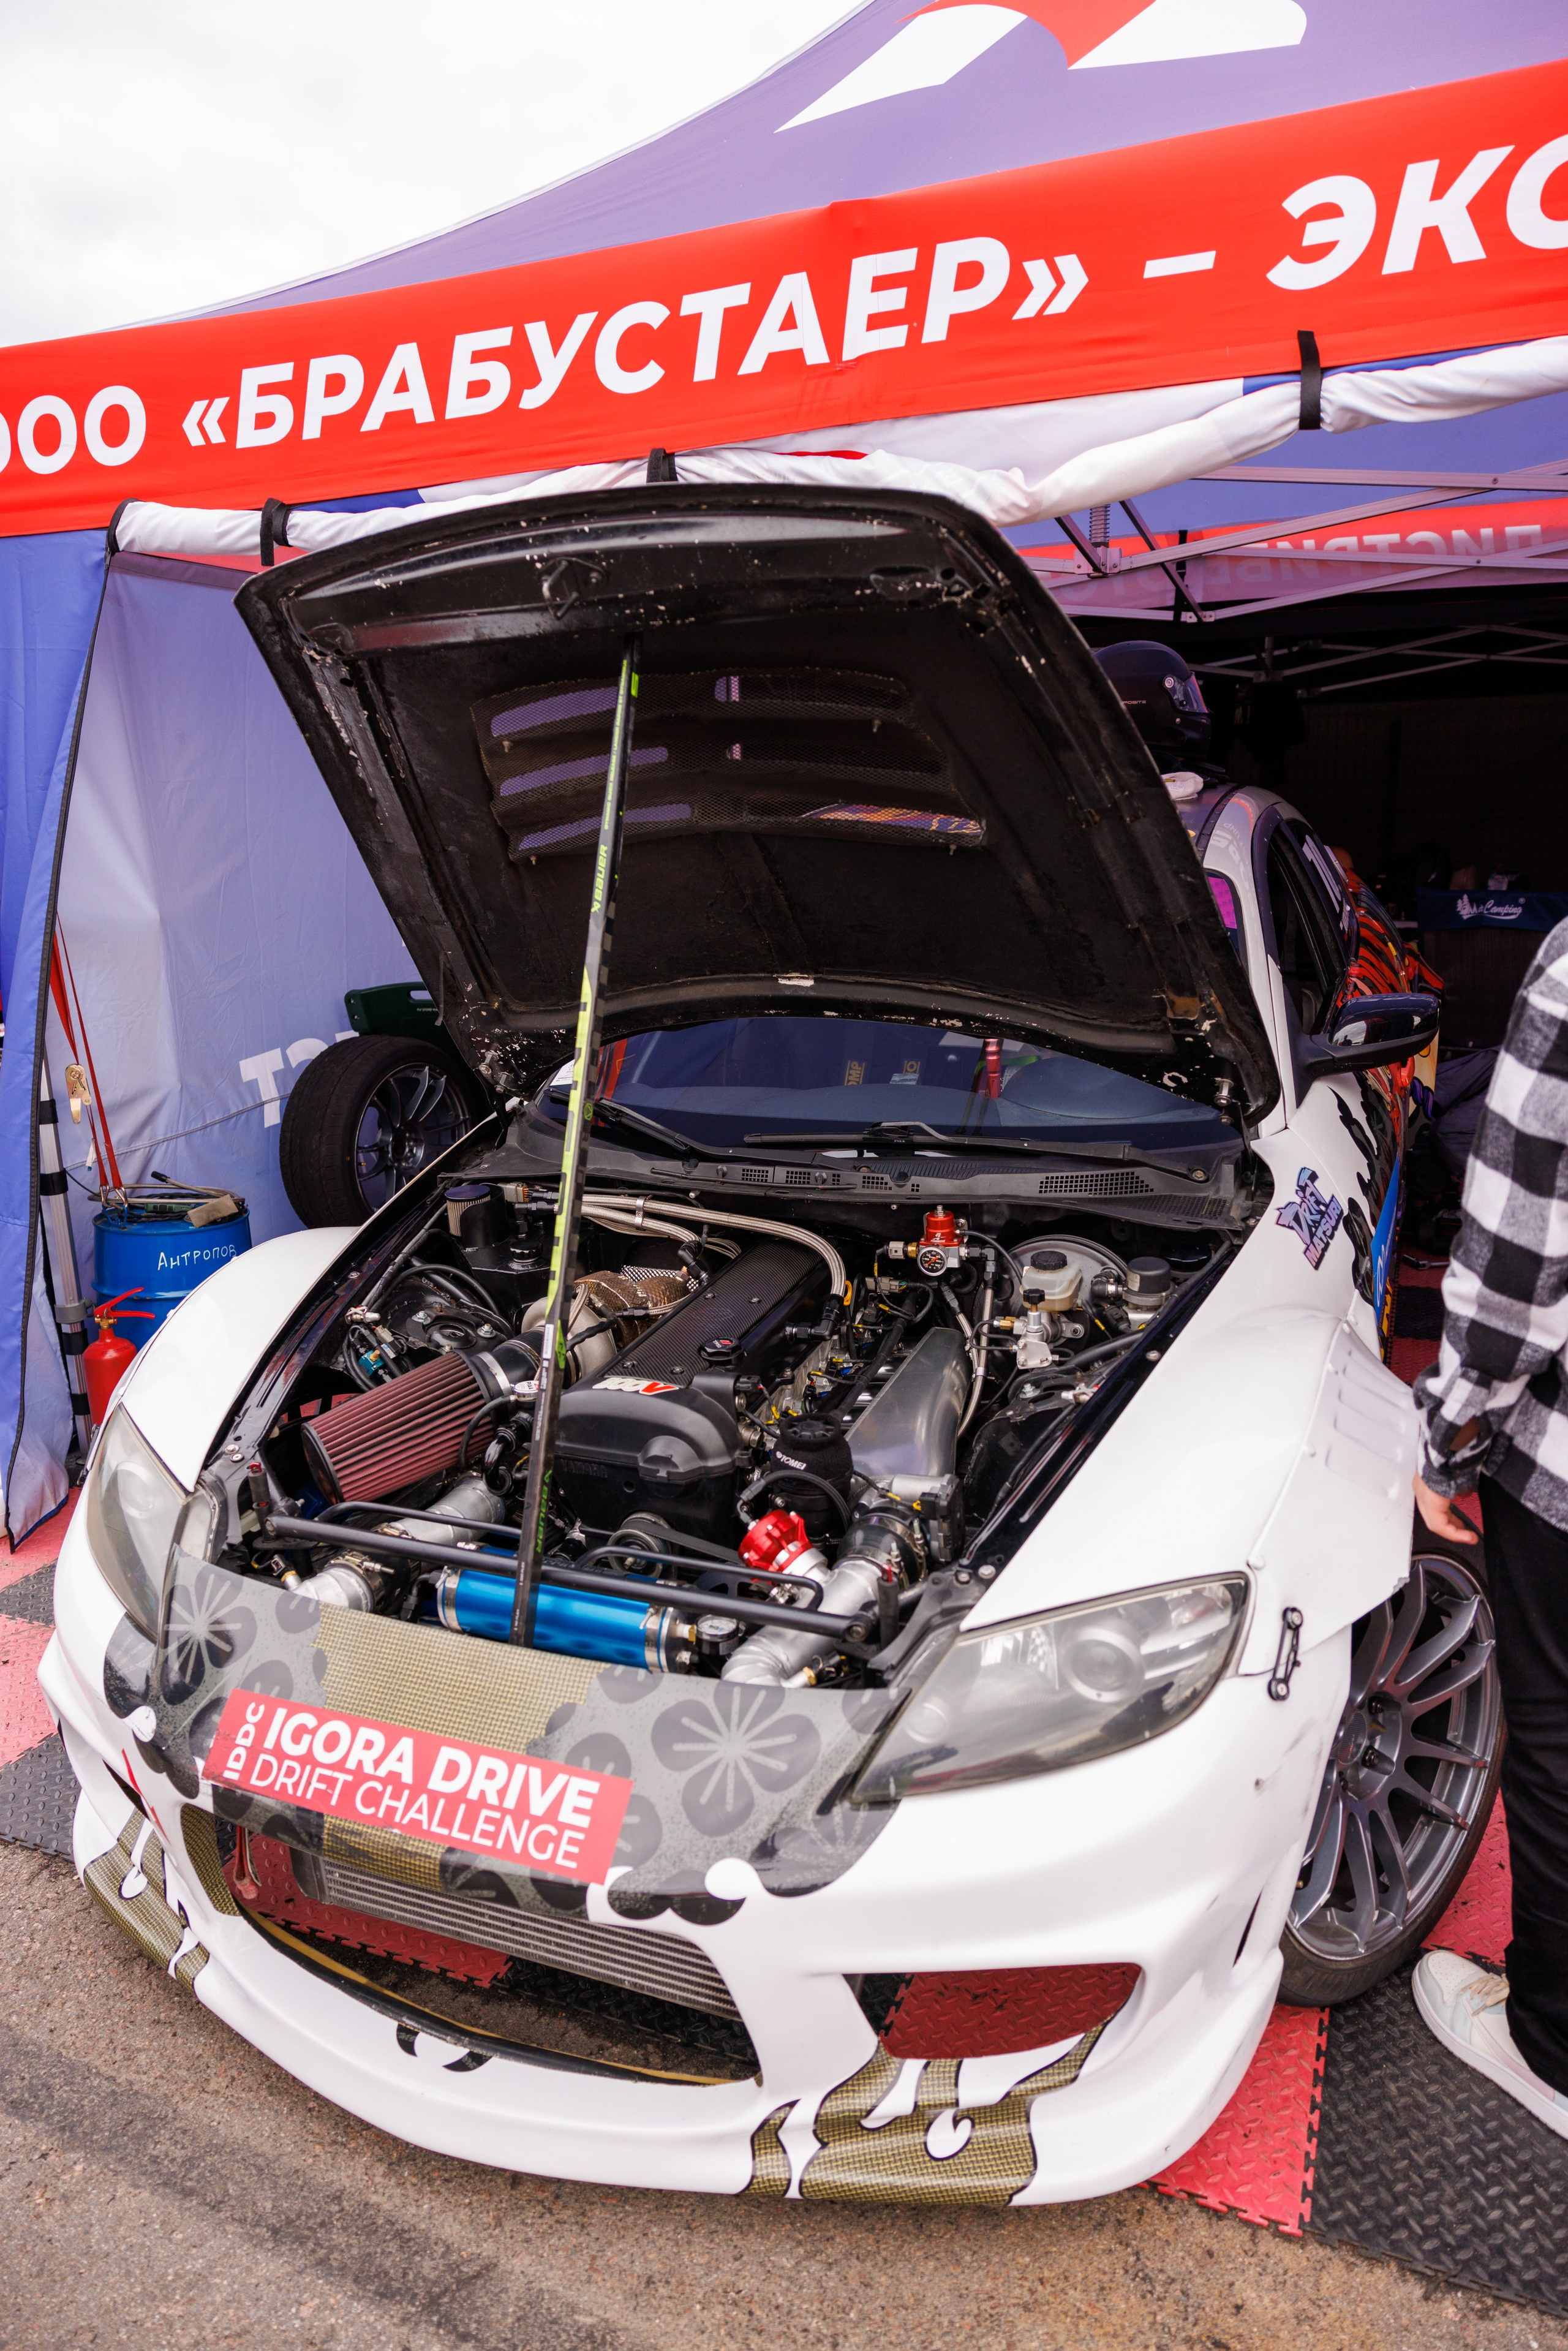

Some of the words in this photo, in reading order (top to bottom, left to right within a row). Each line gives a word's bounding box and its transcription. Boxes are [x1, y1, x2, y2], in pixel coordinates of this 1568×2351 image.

[0, 385, 146, 475] ОО
[182, 236, 1089, 448] «БРАБУСТАЕР»
[1303, 1193, 1344, 1271] MATSURI
[780, 1454, 807, 1470] TOMEI
[223, 1702, 266, 1779] IDDC
[263, 1707, 413, 1784] IGORA
[428, 1746, 600, 1828] DRIVE
[250, 1754, 353, 1806] DRIFT
[355, 1783, 586, 1869] CHALLENGE
